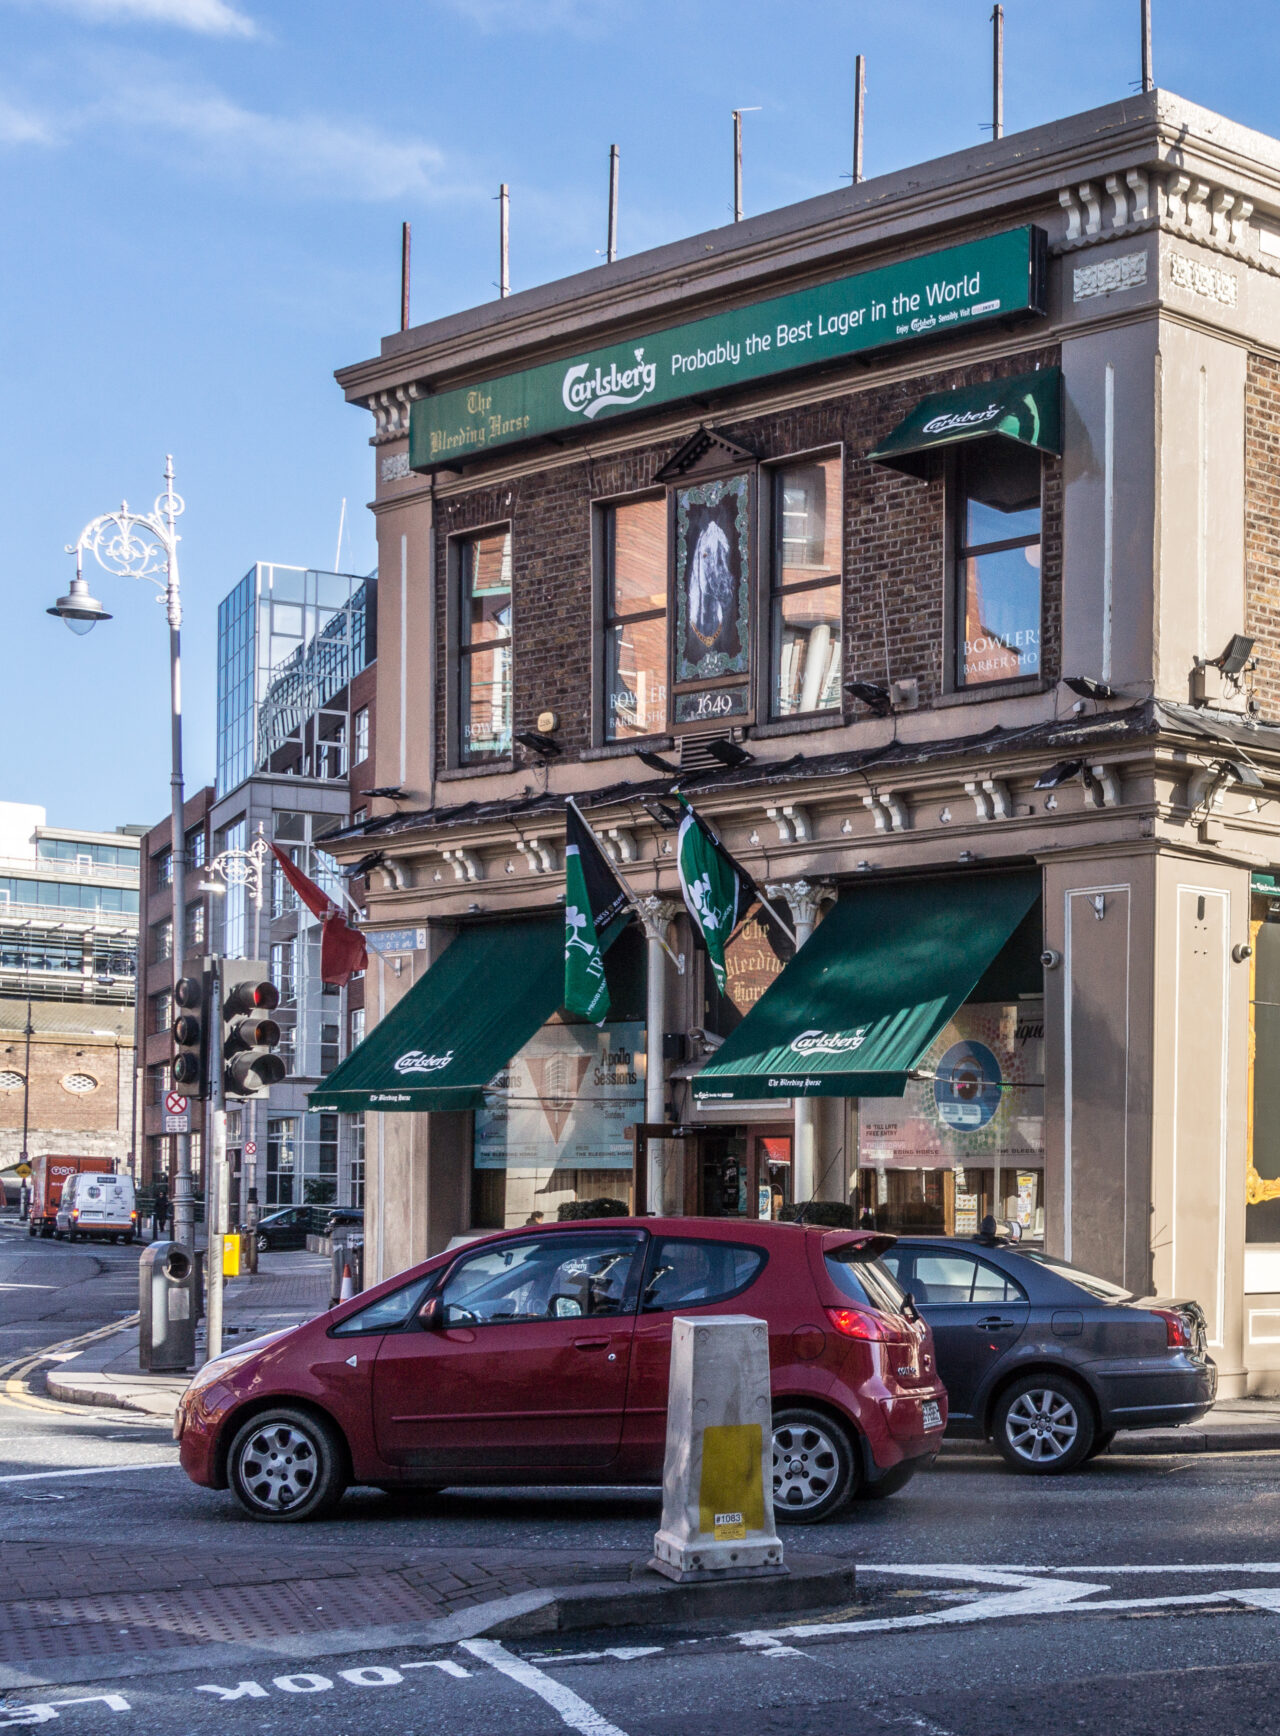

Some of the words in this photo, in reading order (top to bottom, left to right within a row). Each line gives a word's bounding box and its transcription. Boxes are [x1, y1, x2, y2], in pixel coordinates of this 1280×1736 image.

[671, 340, 740, 375] Probably
[746, 333, 771, 356] the
[776, 321, 813, 347] Best
[818, 311, 863, 336] Lager
[871, 300, 886, 322] in
[892, 292, 920, 316] the
[925, 272, 980, 307] World
[562, 350, 657, 417] Carlsberg
[467, 391, 492, 416] The
[923, 403, 1001, 433] Carlsberg
[430, 427, 486, 460] Bleeding
[488, 414, 530, 444] Horse
[963, 655, 1008, 675] BARBER
[1010, 652, 1037, 666] SHO
[697, 694, 732, 714] 1649
[733, 981, 768, 1004] Hor
[790, 1028, 867, 1057] Carlsberg
[394, 1050, 454, 1074] Carlsberg
[600, 1047, 630, 1067] Apollo
[594, 1068, 637, 1086] Sessions
[716, 1514, 741, 1524] #1083
[197, 1659, 473, 1701] LOOK
